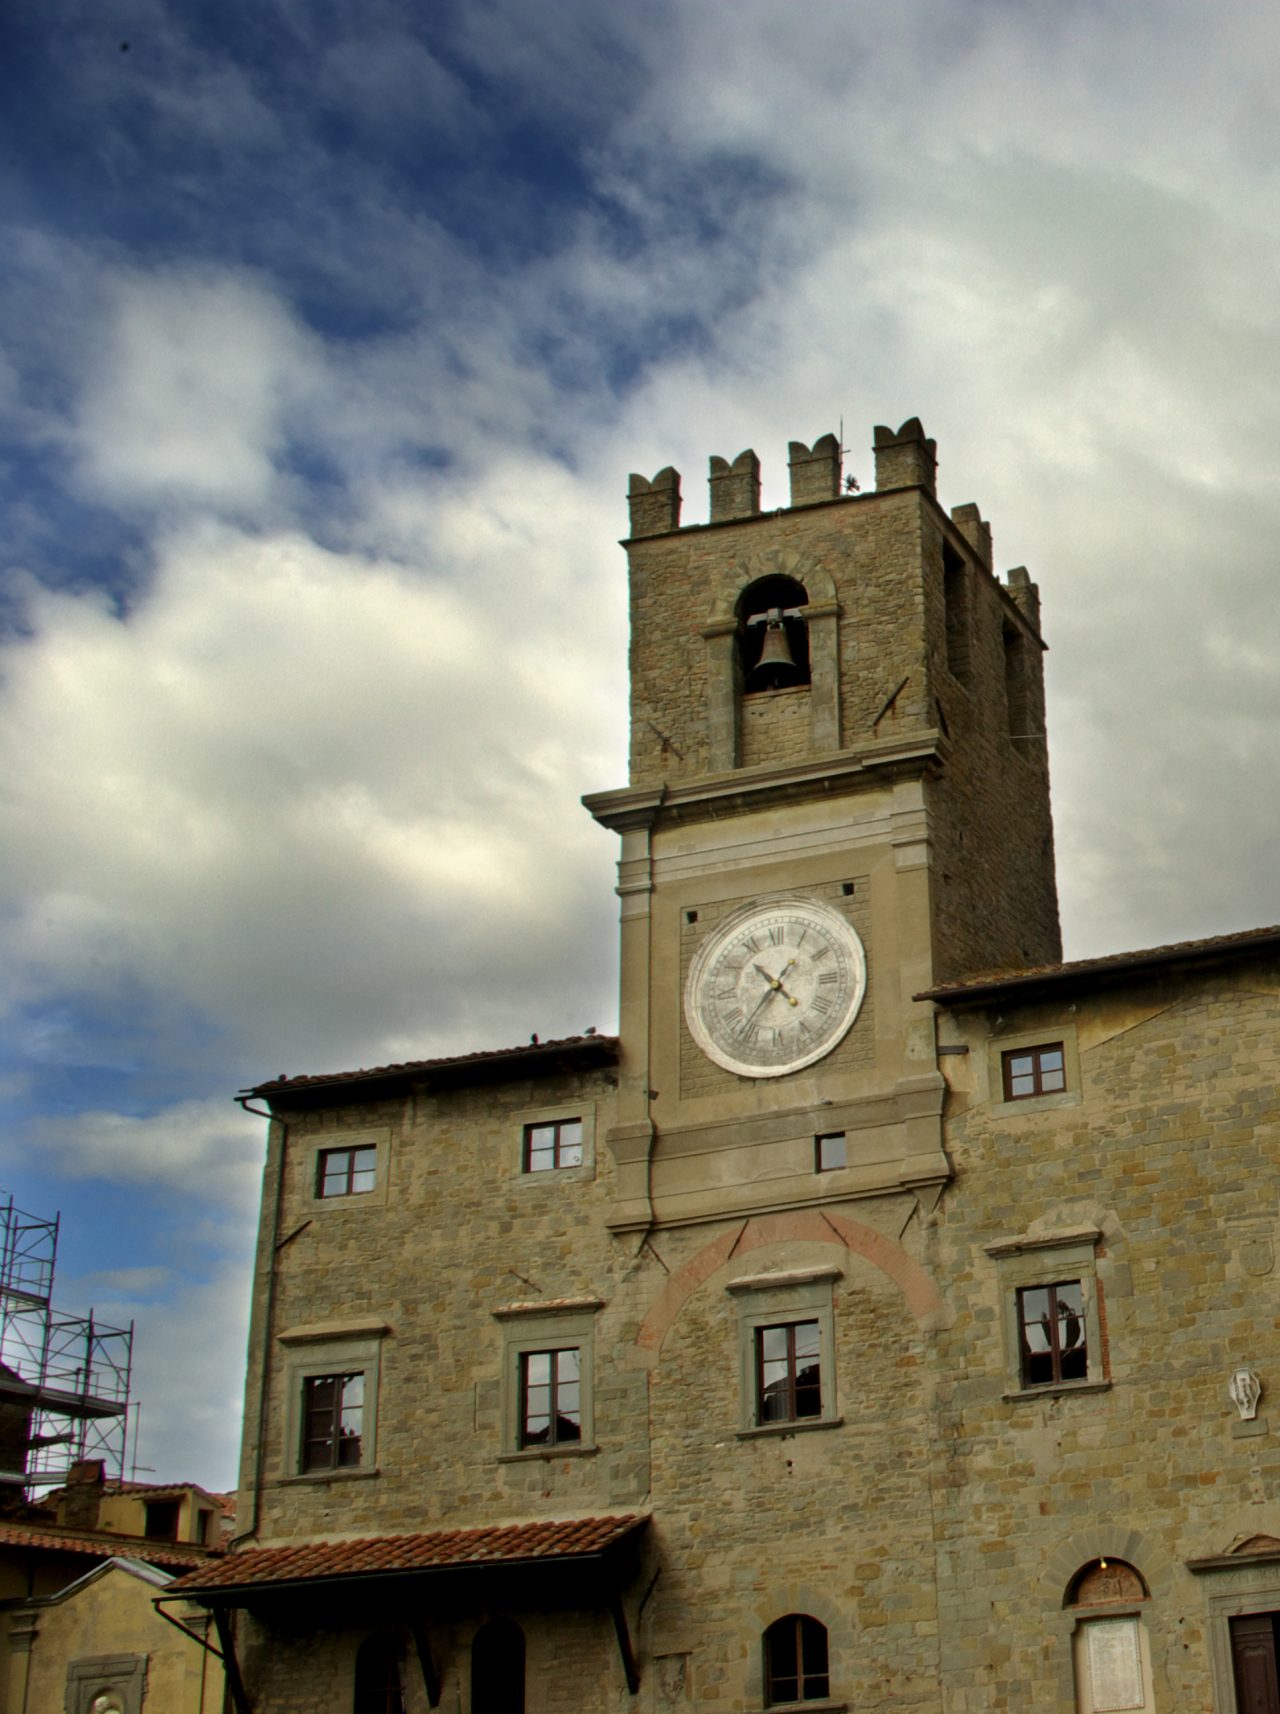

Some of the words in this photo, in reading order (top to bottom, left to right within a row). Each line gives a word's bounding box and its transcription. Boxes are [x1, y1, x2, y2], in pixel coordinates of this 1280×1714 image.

[768, 925, 785, 947] XII
[810, 946, 831, 962] II
[818, 971, 838, 985] III
[810, 995, 833, 1015] IIII
